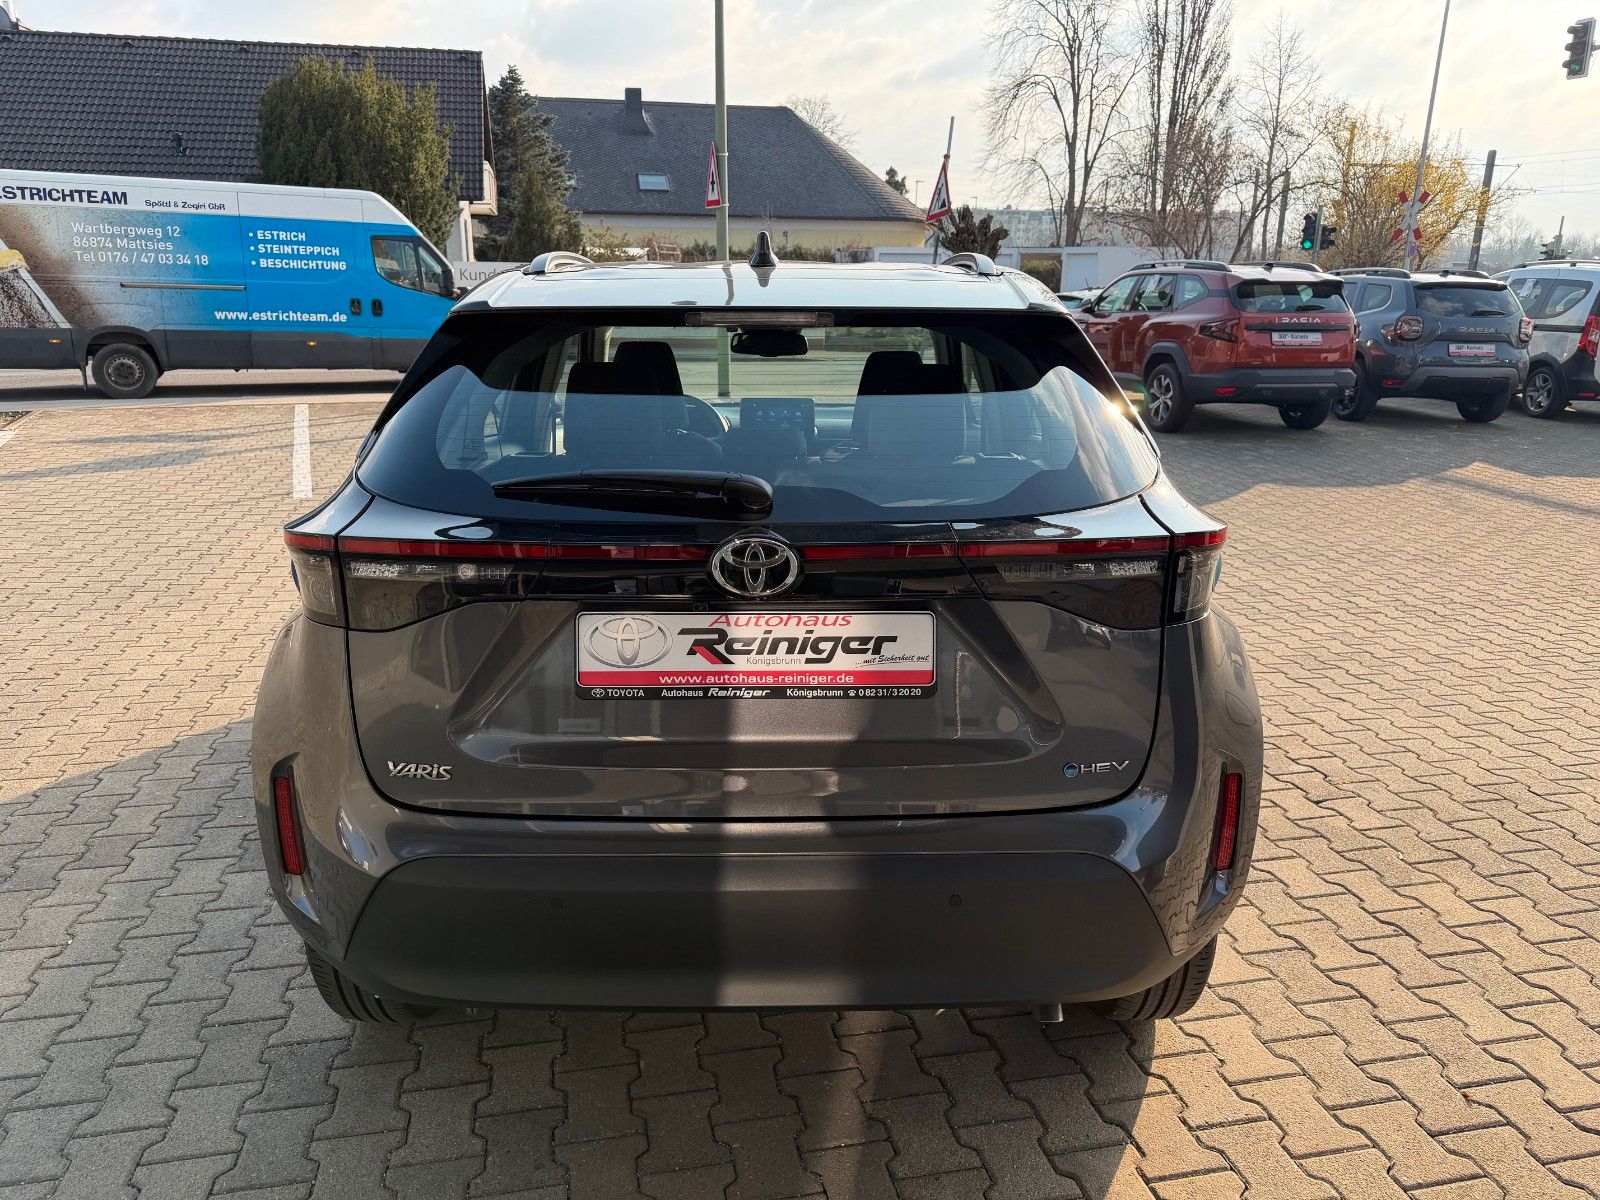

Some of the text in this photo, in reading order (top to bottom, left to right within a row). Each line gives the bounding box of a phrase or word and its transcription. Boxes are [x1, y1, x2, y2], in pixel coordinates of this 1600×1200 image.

[0, 186, 128, 205] STRICHTEAM
[71, 222, 181, 238] Wartbergweg 12
[257, 230, 306, 242] ESTRICH
[73, 237, 173, 250] 86874 Mattsies
[258, 244, 340, 256] STEINTEPPICH
[75, 251, 209, 266] Tel 0176 / 47 03 34 18
[260, 259, 347, 271] BESCHICHTUNG
[214, 310, 348, 323] www.estrichteam.de
[708, 615, 852, 627] Autohaus
[677, 628, 898, 665] Reiniger
[746, 657, 801, 666] Königsbrunn
[658, 672, 855, 685] www.autohaus-reiniger.de
[607, 689, 645, 697] TOYOTA
[661, 689, 704, 697] Autohaus
[708, 687, 771, 698] Reiniger
[787, 688, 843, 698] Königsbrunn
[1080, 760, 1130, 774] HEV
